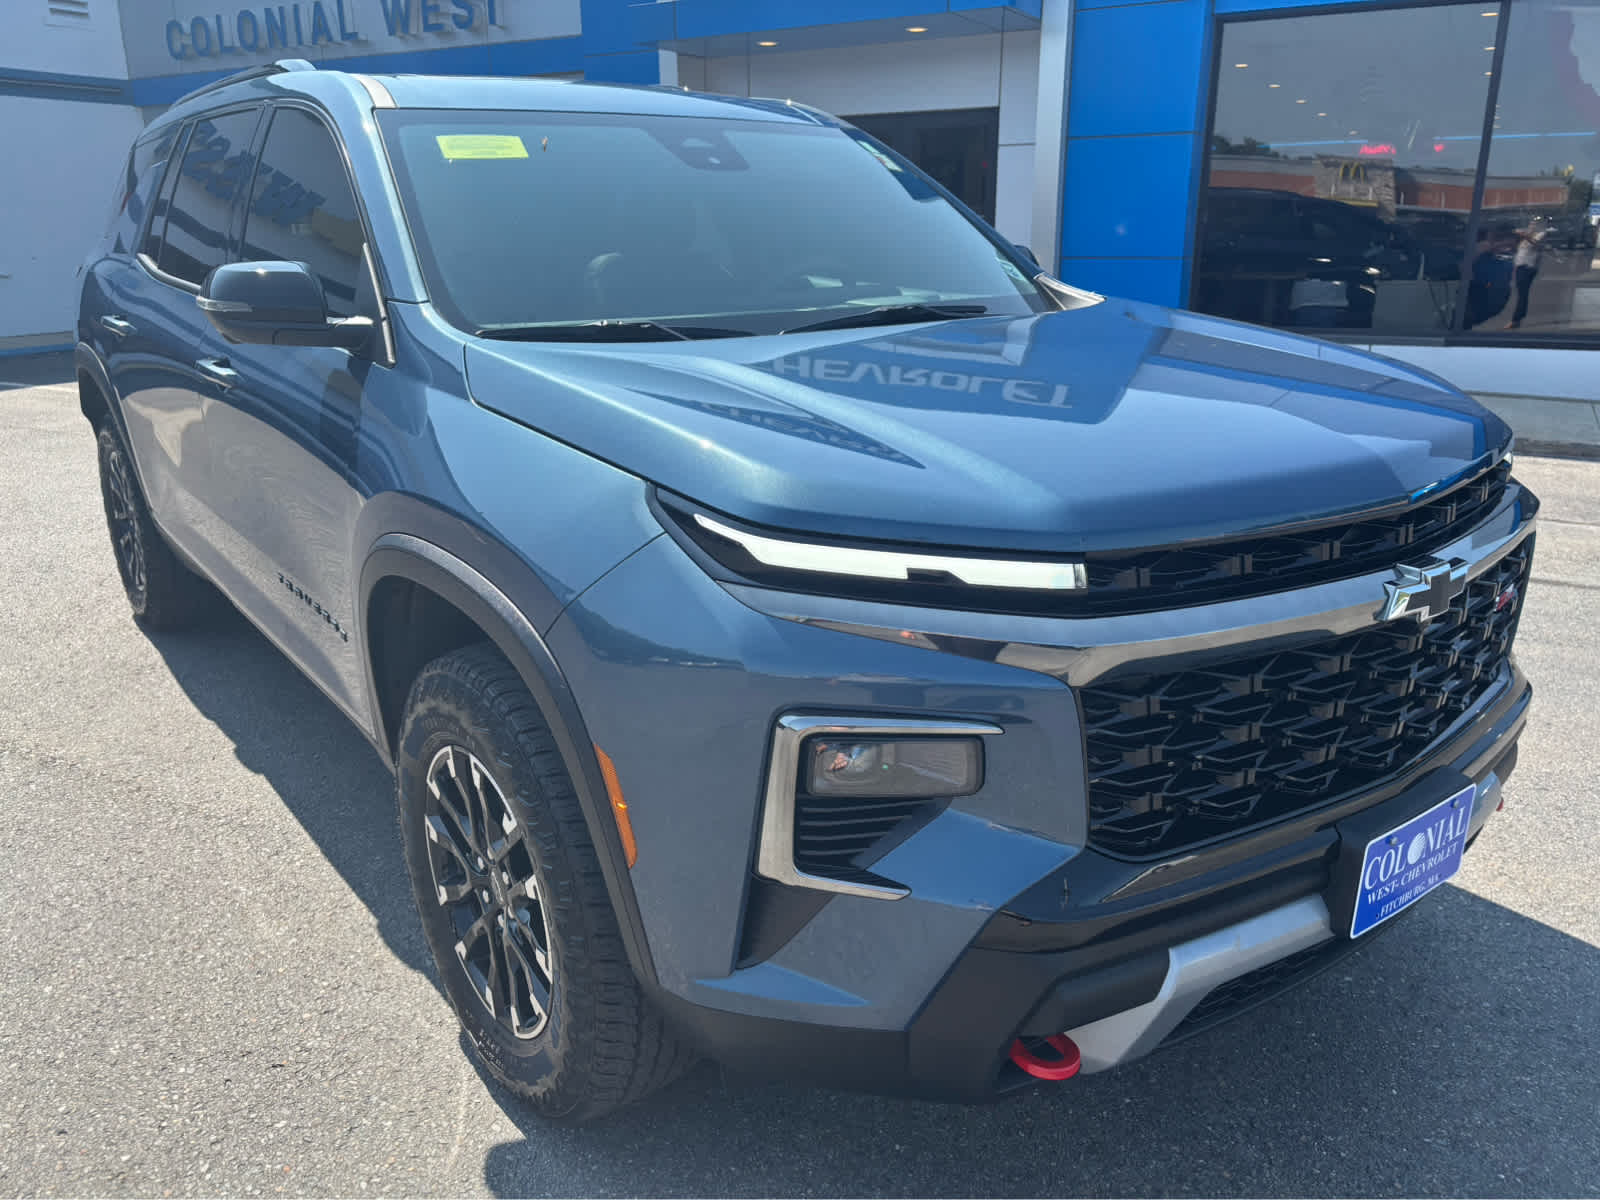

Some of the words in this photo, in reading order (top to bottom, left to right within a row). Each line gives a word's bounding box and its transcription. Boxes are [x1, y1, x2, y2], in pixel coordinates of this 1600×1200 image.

[165, 0, 359, 60] COLONIAL
[379, 0, 498, 36] WEST
[1364, 807, 1466, 890] COLONIAL
[1401, 842, 1458, 886] CHEVROLET
